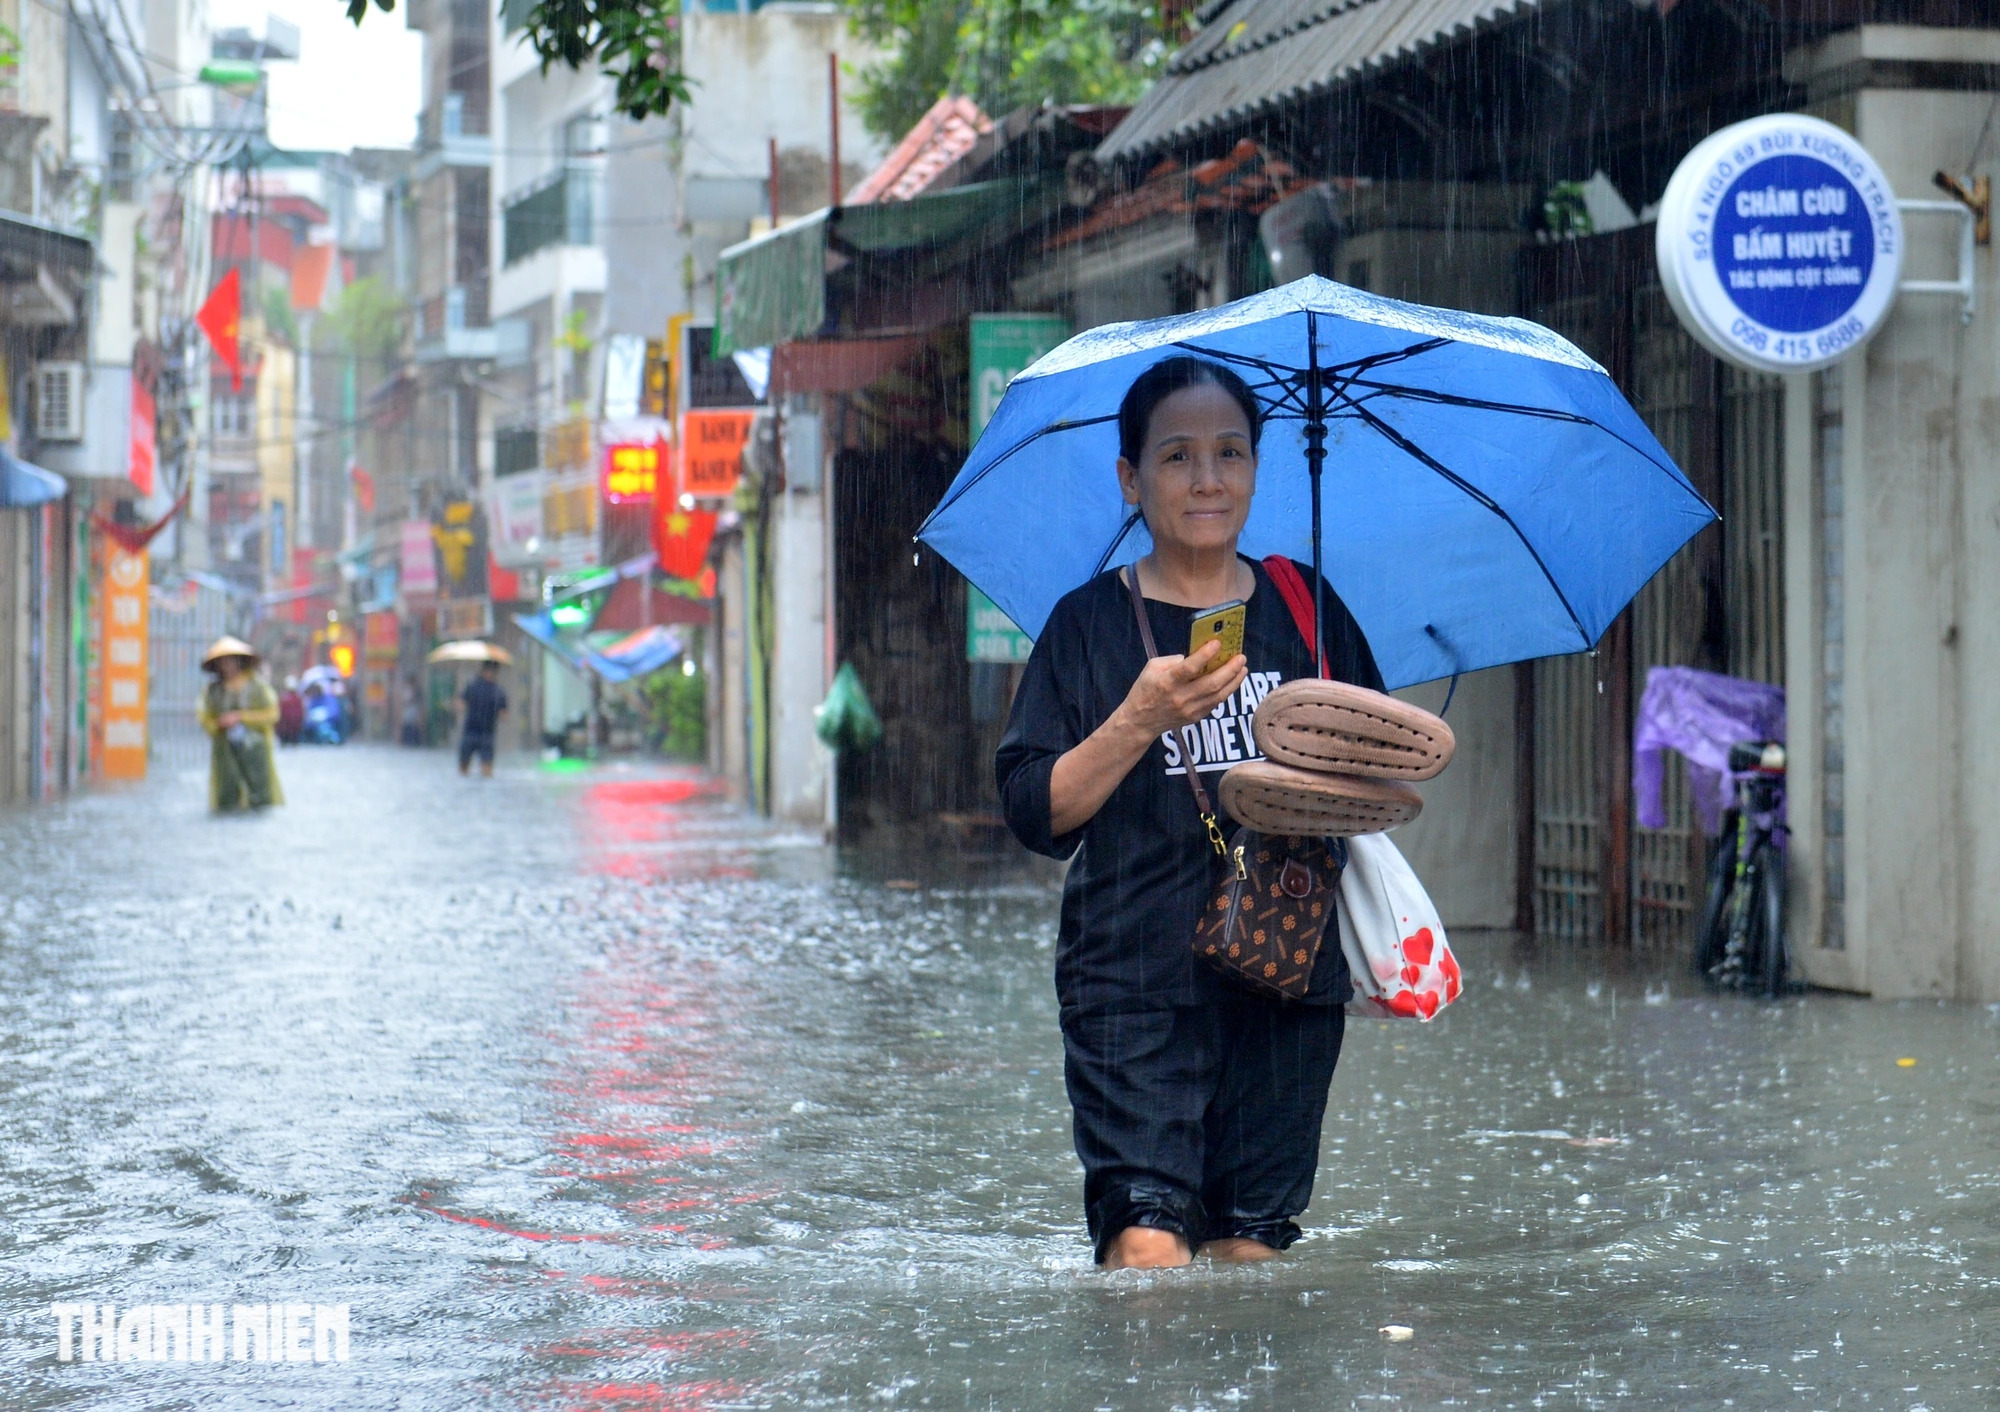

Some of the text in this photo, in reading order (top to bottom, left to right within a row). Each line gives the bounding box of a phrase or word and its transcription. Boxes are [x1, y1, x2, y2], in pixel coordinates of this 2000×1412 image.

[1735, 185, 1799, 217] CHÂM
[1732, 225, 1852, 262] BẤM HUYỆT
[1731, 318, 1768, 352] 098
[1774, 339, 1811, 359] 415
